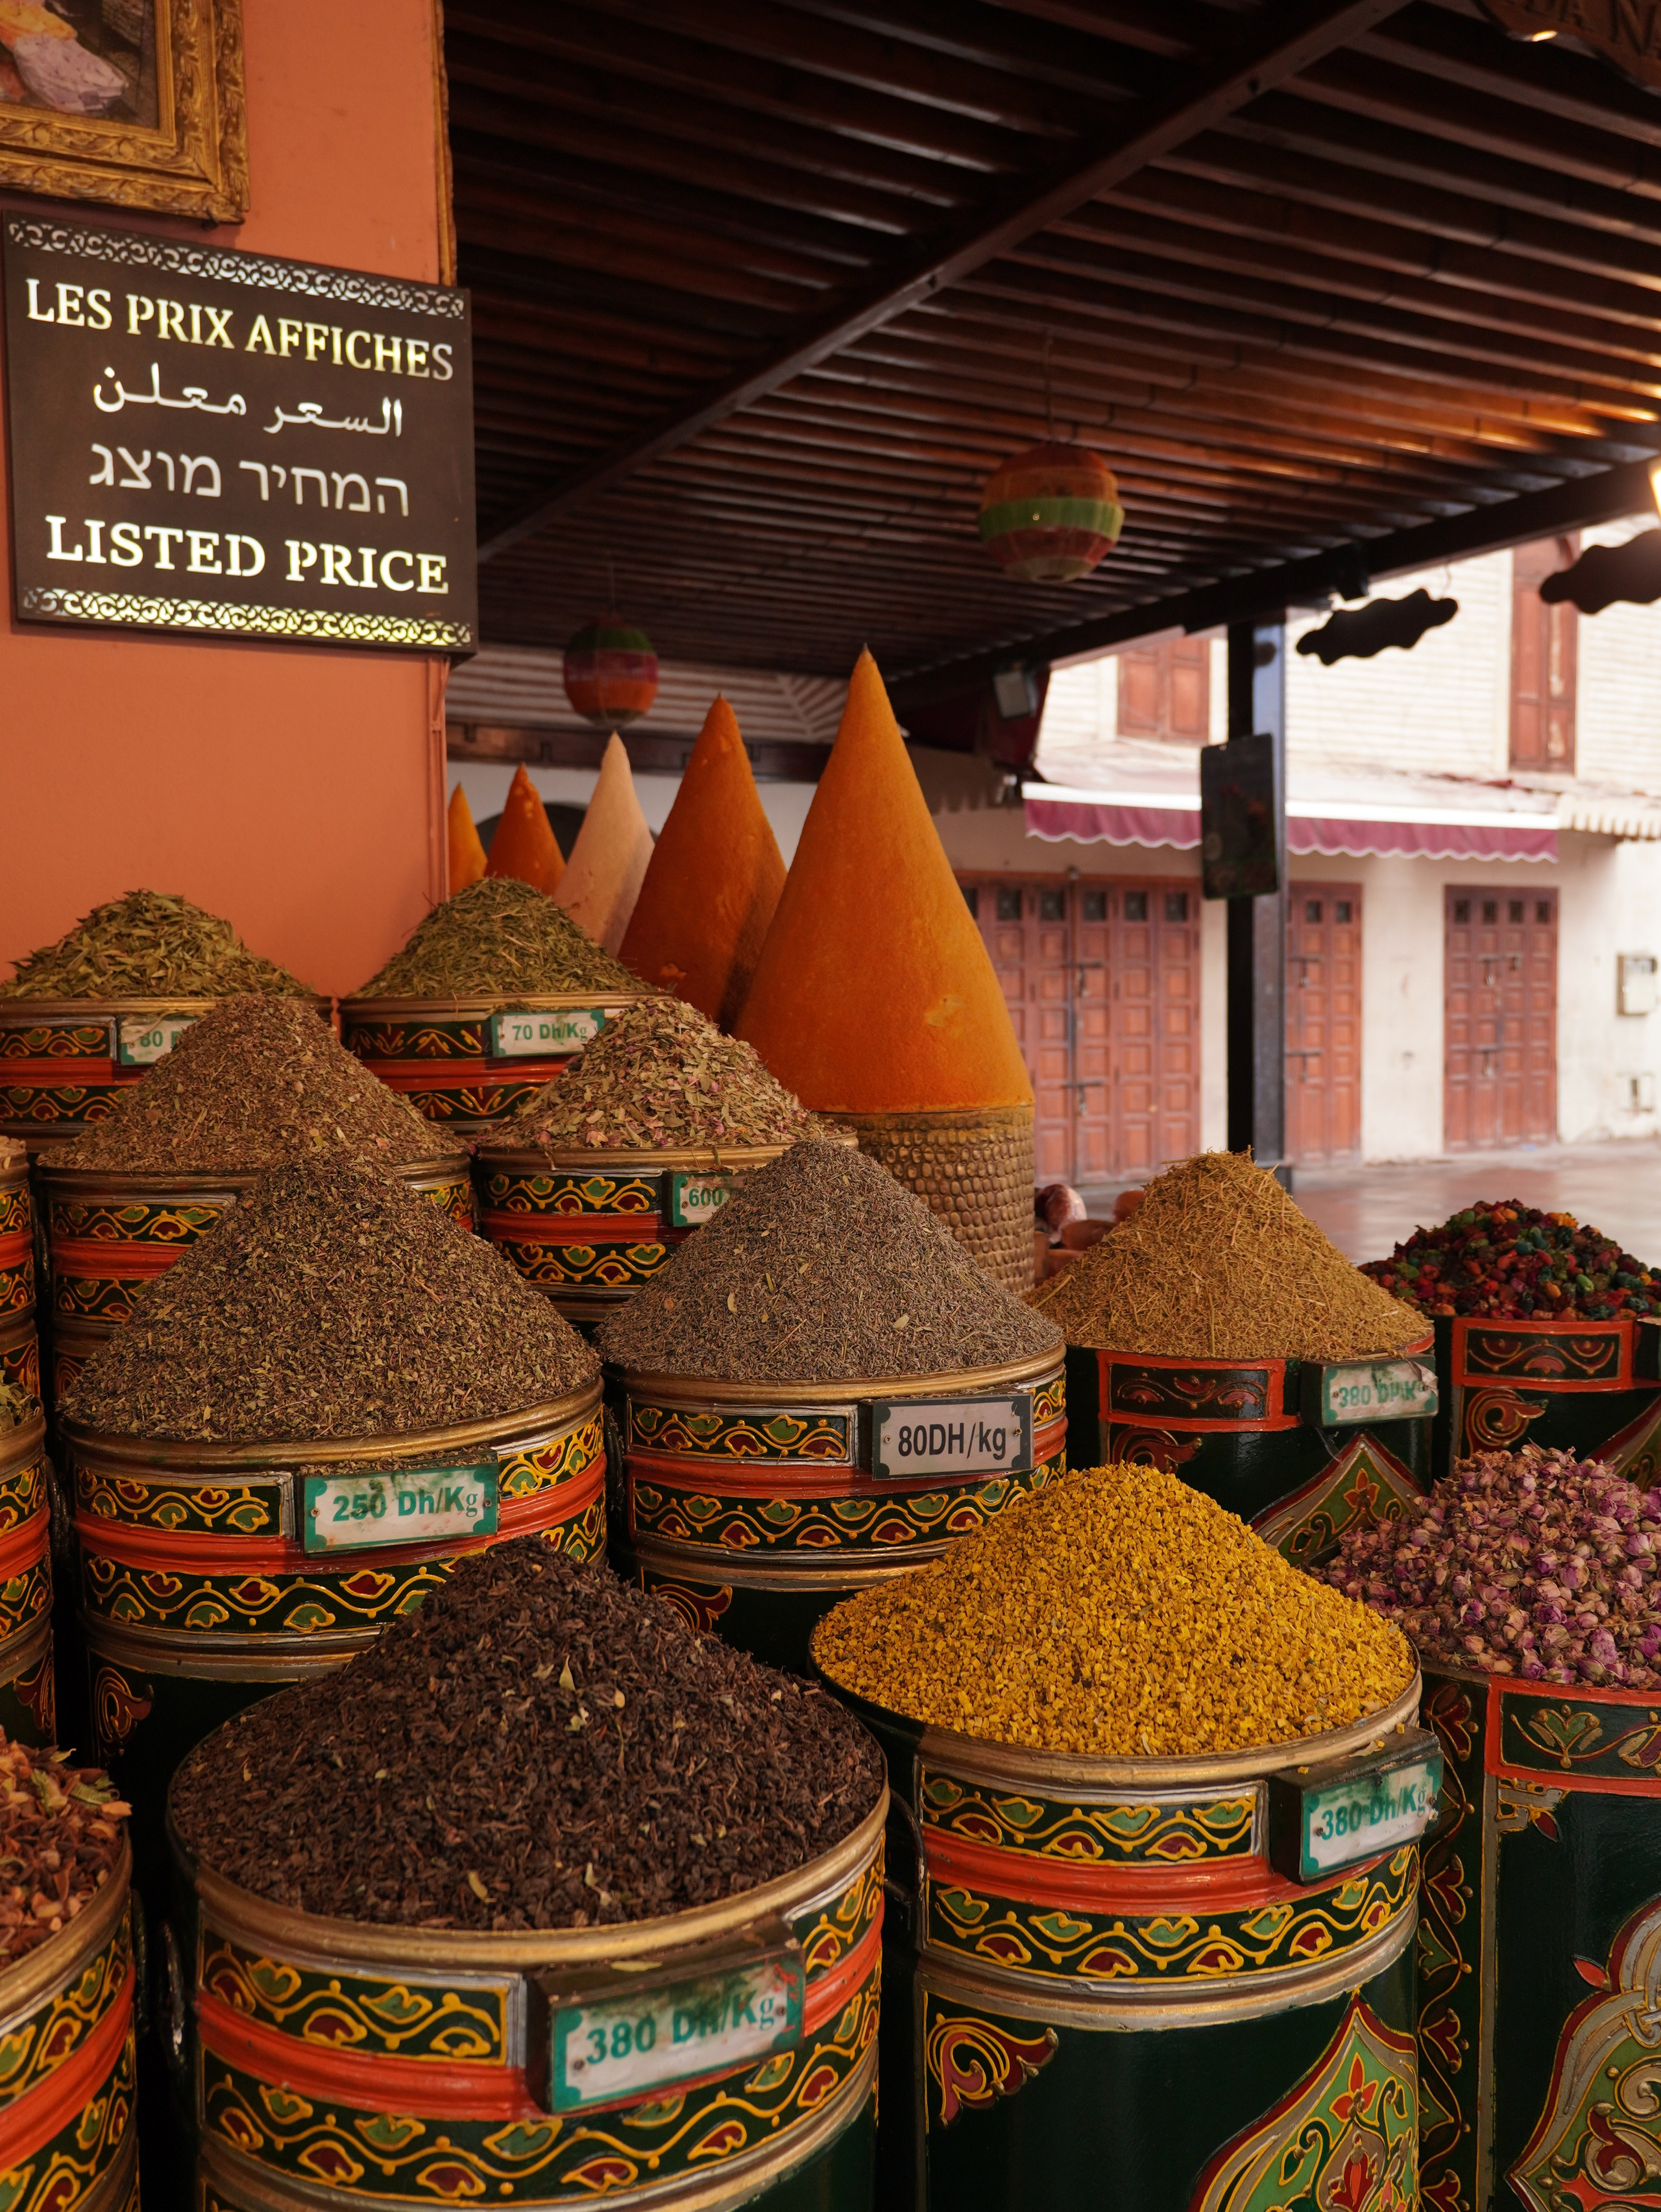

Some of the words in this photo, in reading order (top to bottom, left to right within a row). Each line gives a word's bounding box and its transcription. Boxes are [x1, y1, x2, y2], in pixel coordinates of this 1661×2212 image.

[26, 278, 113, 331] LES
[125, 293, 236, 350] PRIX
[245, 315, 454, 381] AFFICHES
[93, 363, 247, 416] معلن
[263, 396, 402, 437] السعر
[89, 443, 222, 498] מוצג
[239, 461, 409, 517] המחיר
[45, 515, 266, 578] LISTED
[284, 539, 450, 595] PRICE
[512, 1024, 533, 1041] 70
[539, 1022, 588, 1042] Dh/Kg
[689, 1187, 723, 1207] 600
[1339, 1384, 1372, 1408] 380
[898, 1421, 1006, 1460] 80DH/kg
[332, 1493, 387, 1522] 250
[398, 1485, 478, 1518] Dh/Kg
[1321, 1800, 1362, 1840] 380
[1370, 1783, 1427, 1826] Dh/Kg
[586, 2015, 657, 2064] 380
[672, 1990, 775, 2045] Dh/Kg
